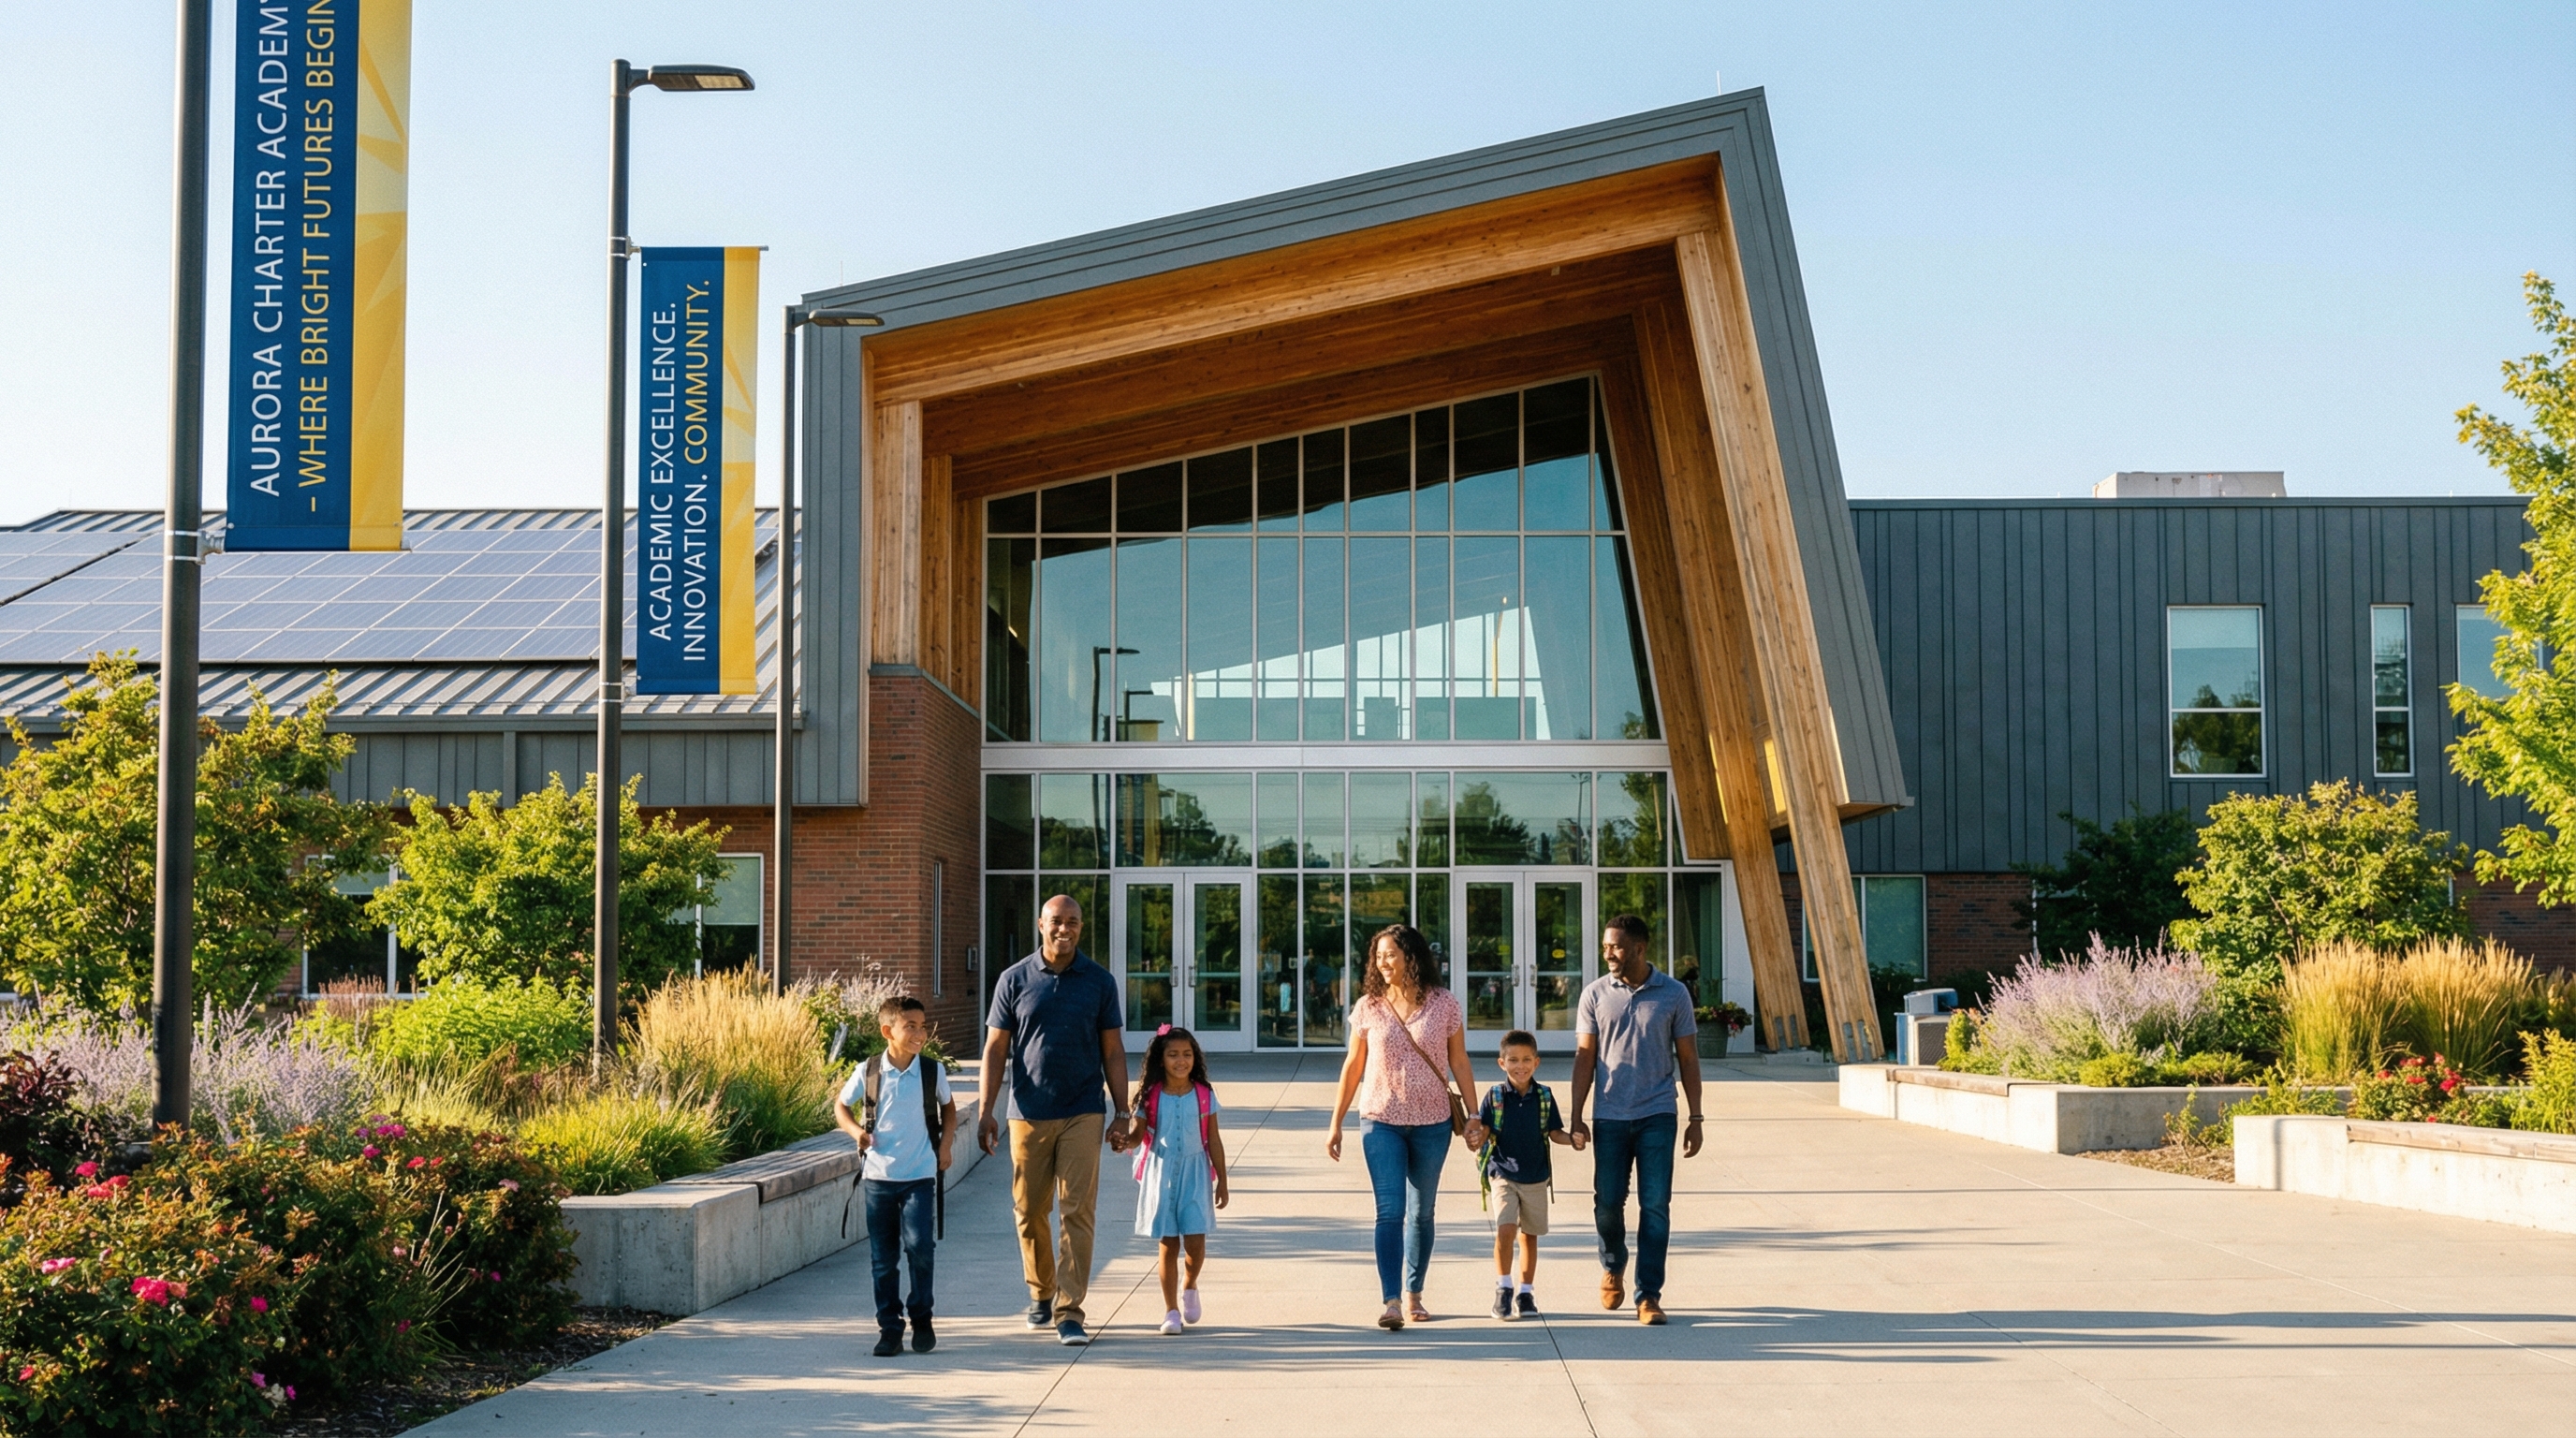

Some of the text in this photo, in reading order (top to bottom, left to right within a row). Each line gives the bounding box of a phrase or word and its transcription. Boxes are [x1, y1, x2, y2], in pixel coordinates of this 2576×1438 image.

[250, 0, 288, 497] AURORA CHARTER ACADEM
[302, 98, 333, 238] FUTURES
[300, 247, 330, 364] BRIGHT
[298, 376, 328, 488] WHERE
[649, 302, 676, 641] ACADEMIC EXCELLENCE.
[683, 280, 710, 661] INNOVATION. COMMUNITY.
